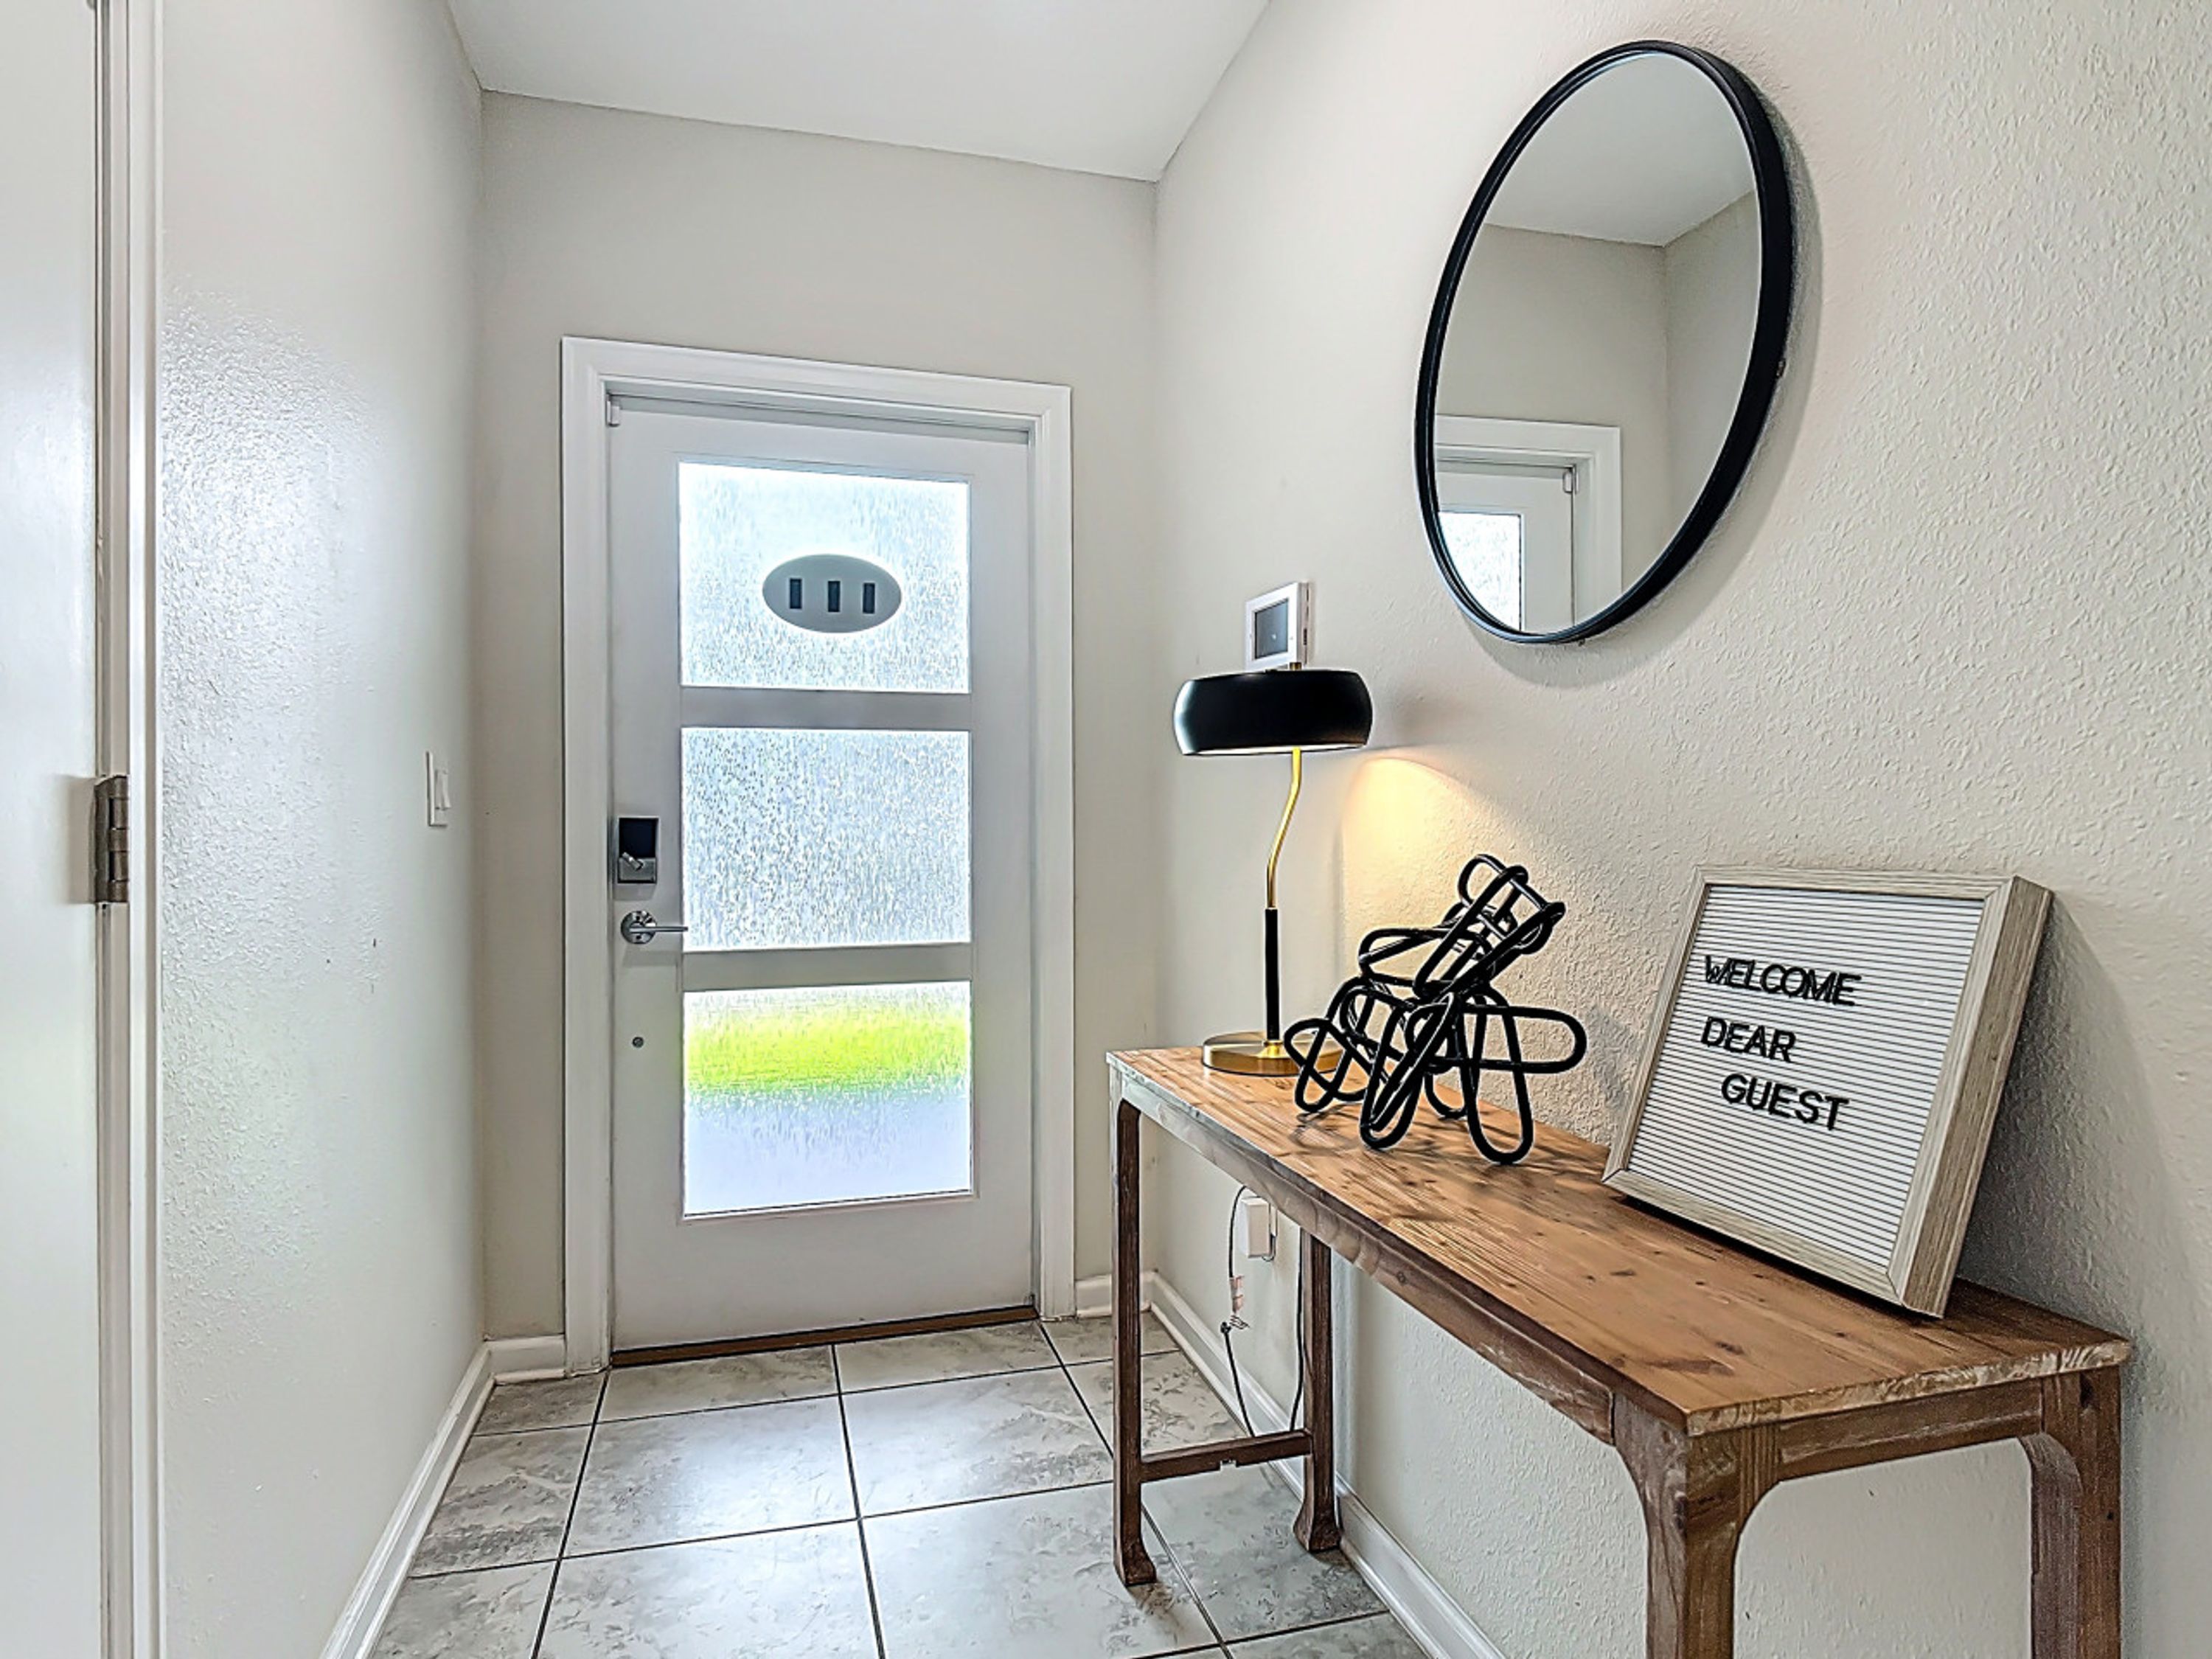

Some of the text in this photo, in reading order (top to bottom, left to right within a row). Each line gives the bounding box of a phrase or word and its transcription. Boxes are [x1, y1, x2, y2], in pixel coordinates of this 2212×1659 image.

[1705, 956, 1862, 1006] WELCOME
[1700, 1016, 1797, 1062] DEAR
[1721, 1074, 1850, 1131] GUEST
